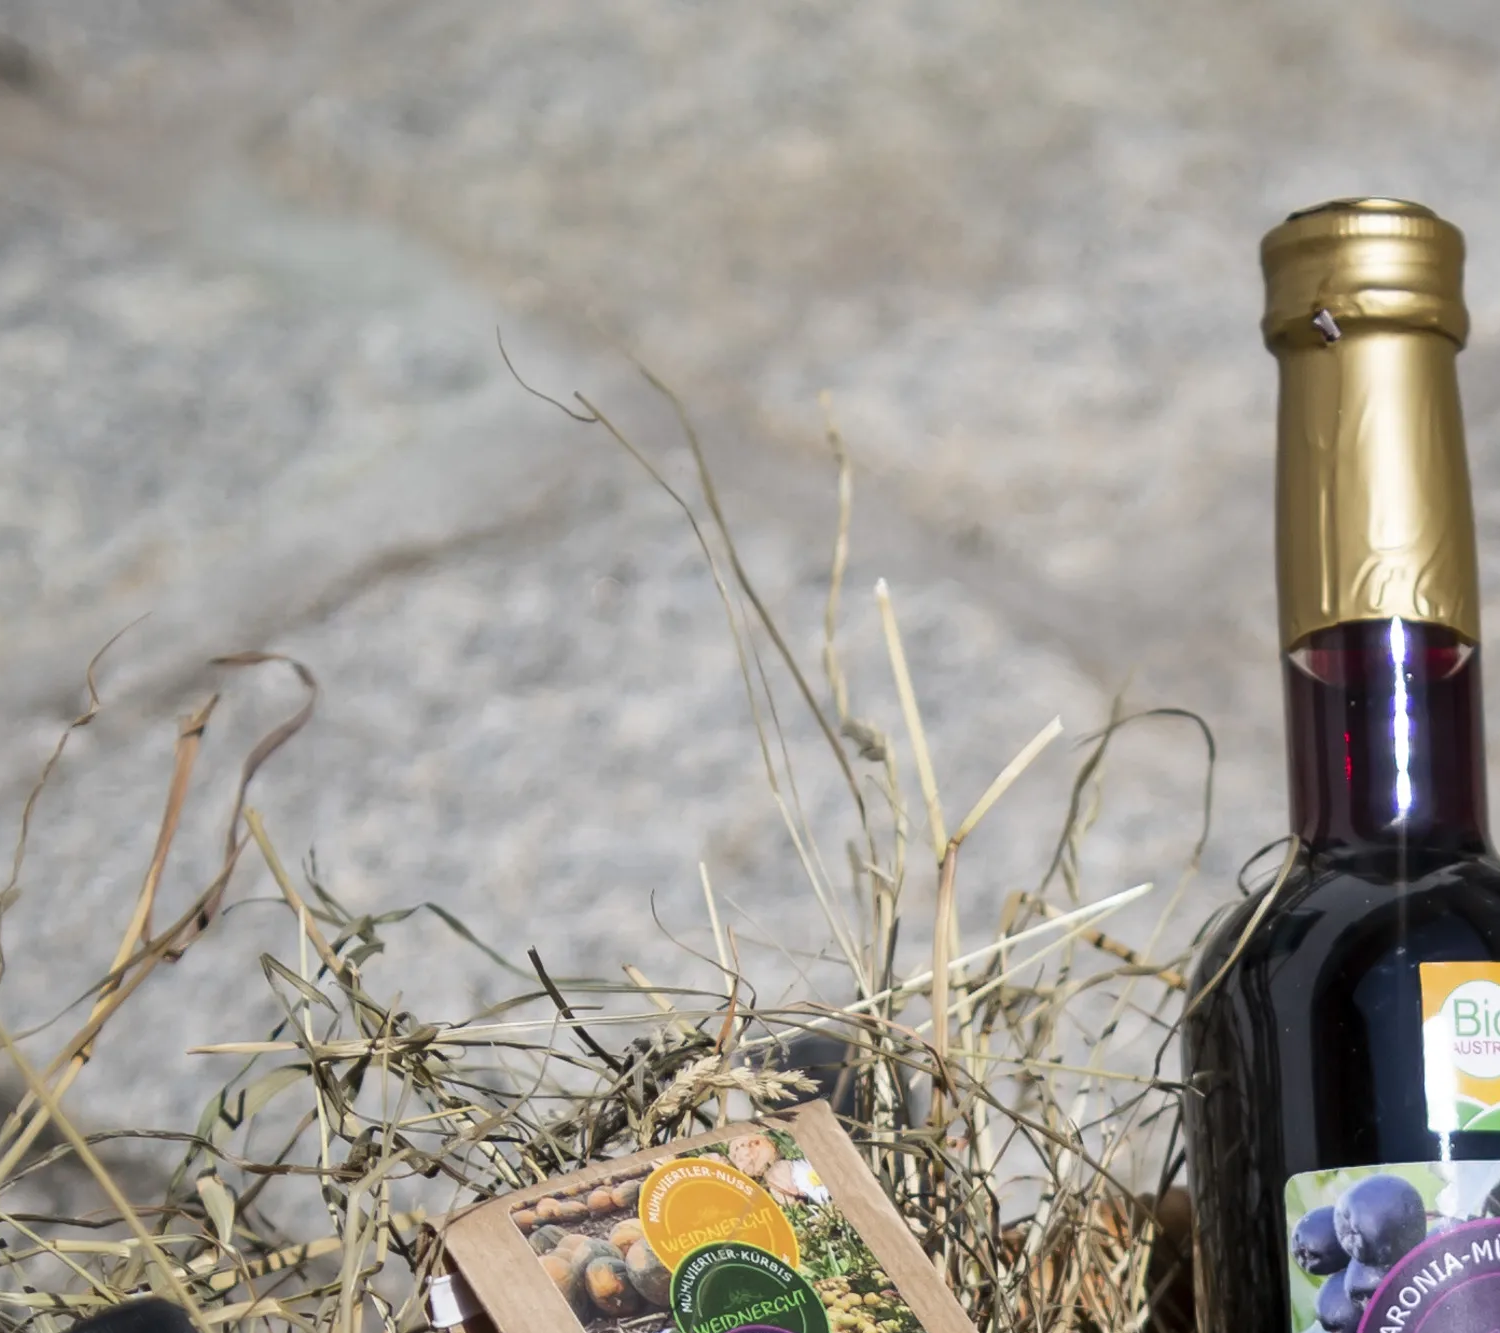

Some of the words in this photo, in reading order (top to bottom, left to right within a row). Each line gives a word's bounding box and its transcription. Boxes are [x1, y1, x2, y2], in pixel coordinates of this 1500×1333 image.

[649, 1166, 754, 1223] MÜHLVIERTLER-NUSS
[660, 1207, 773, 1253] WEIDNERGUT
[681, 1249, 792, 1313] MÜHLVIERTLER-KÜRBIS
